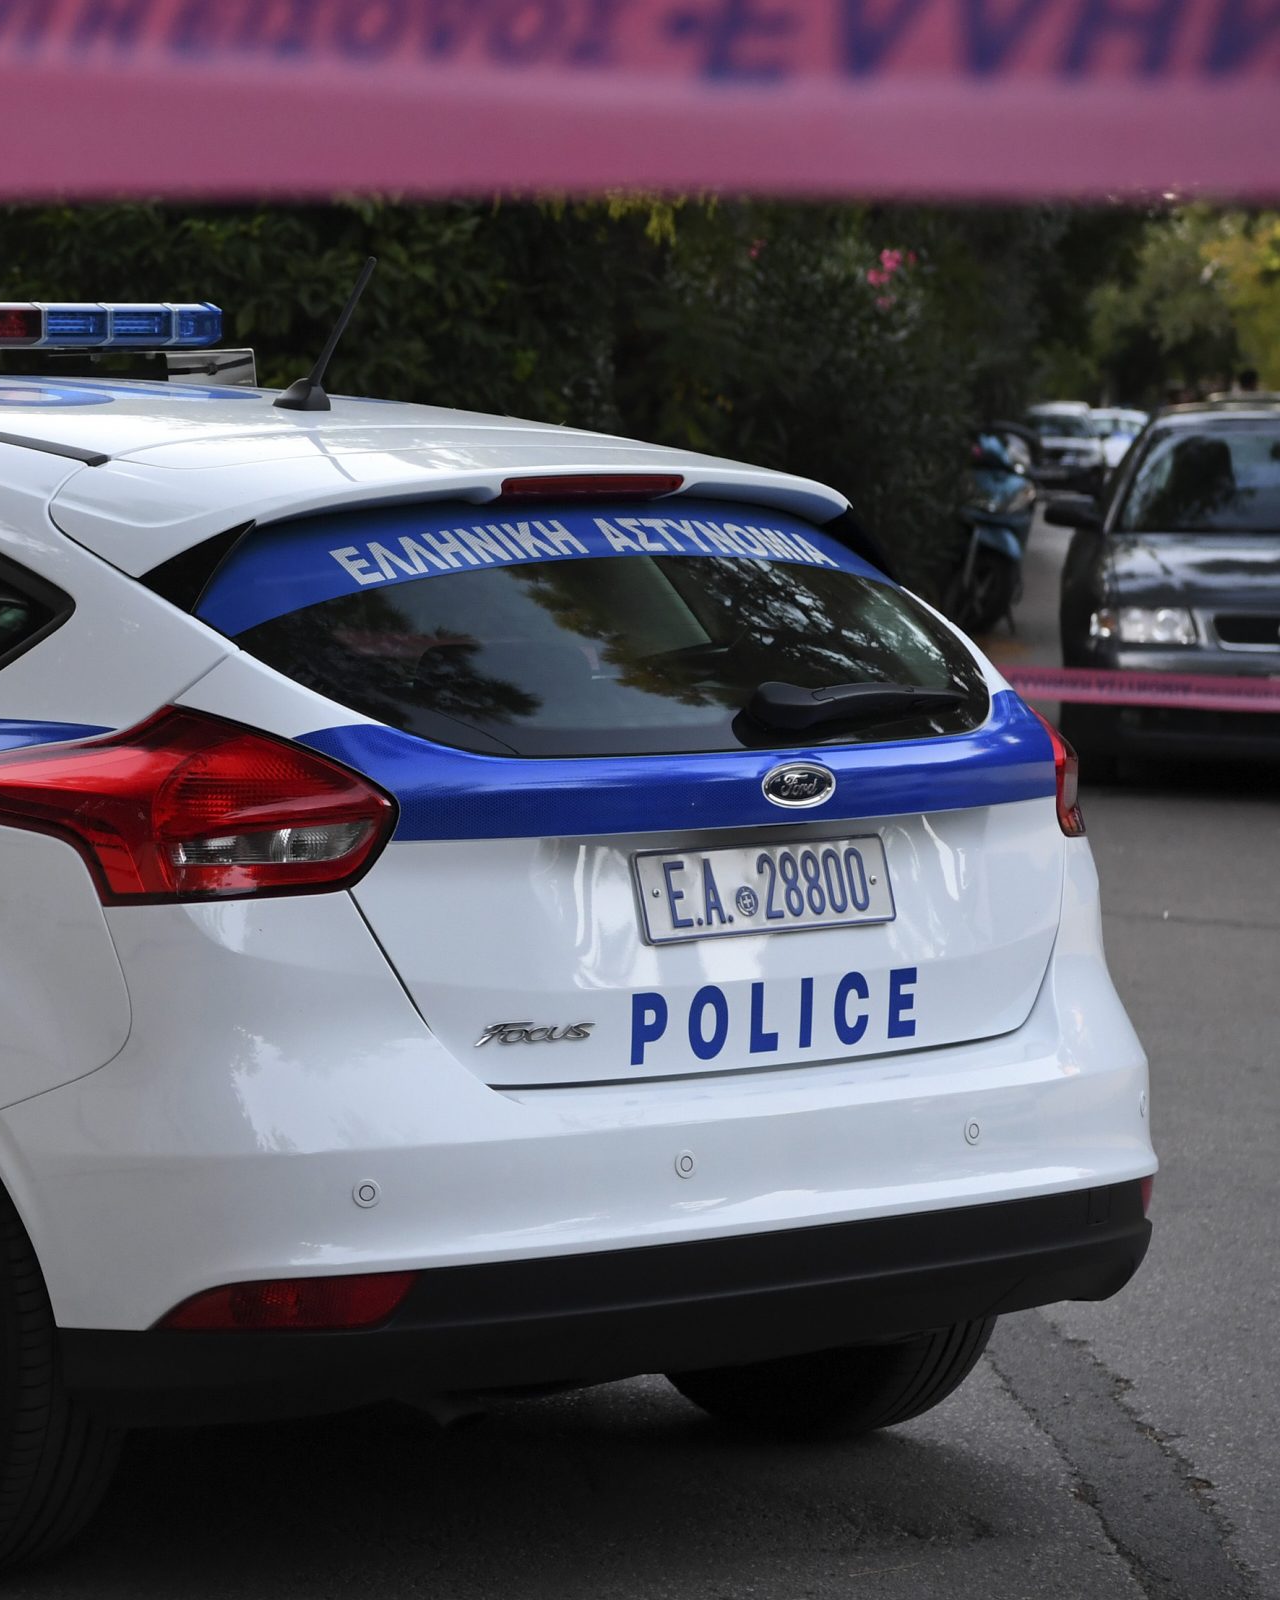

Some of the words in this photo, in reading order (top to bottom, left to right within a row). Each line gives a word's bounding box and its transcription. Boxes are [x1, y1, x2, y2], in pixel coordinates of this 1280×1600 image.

[328, 519, 590, 586] ΕΛΛΗΝΙΚΗ
[592, 517, 840, 568] ΑΣΤΥΝΟΜΙΑ
[781, 773, 818, 796] Ford
[756, 846, 870, 920] 28800
[630, 966, 918, 1067] POLICE
